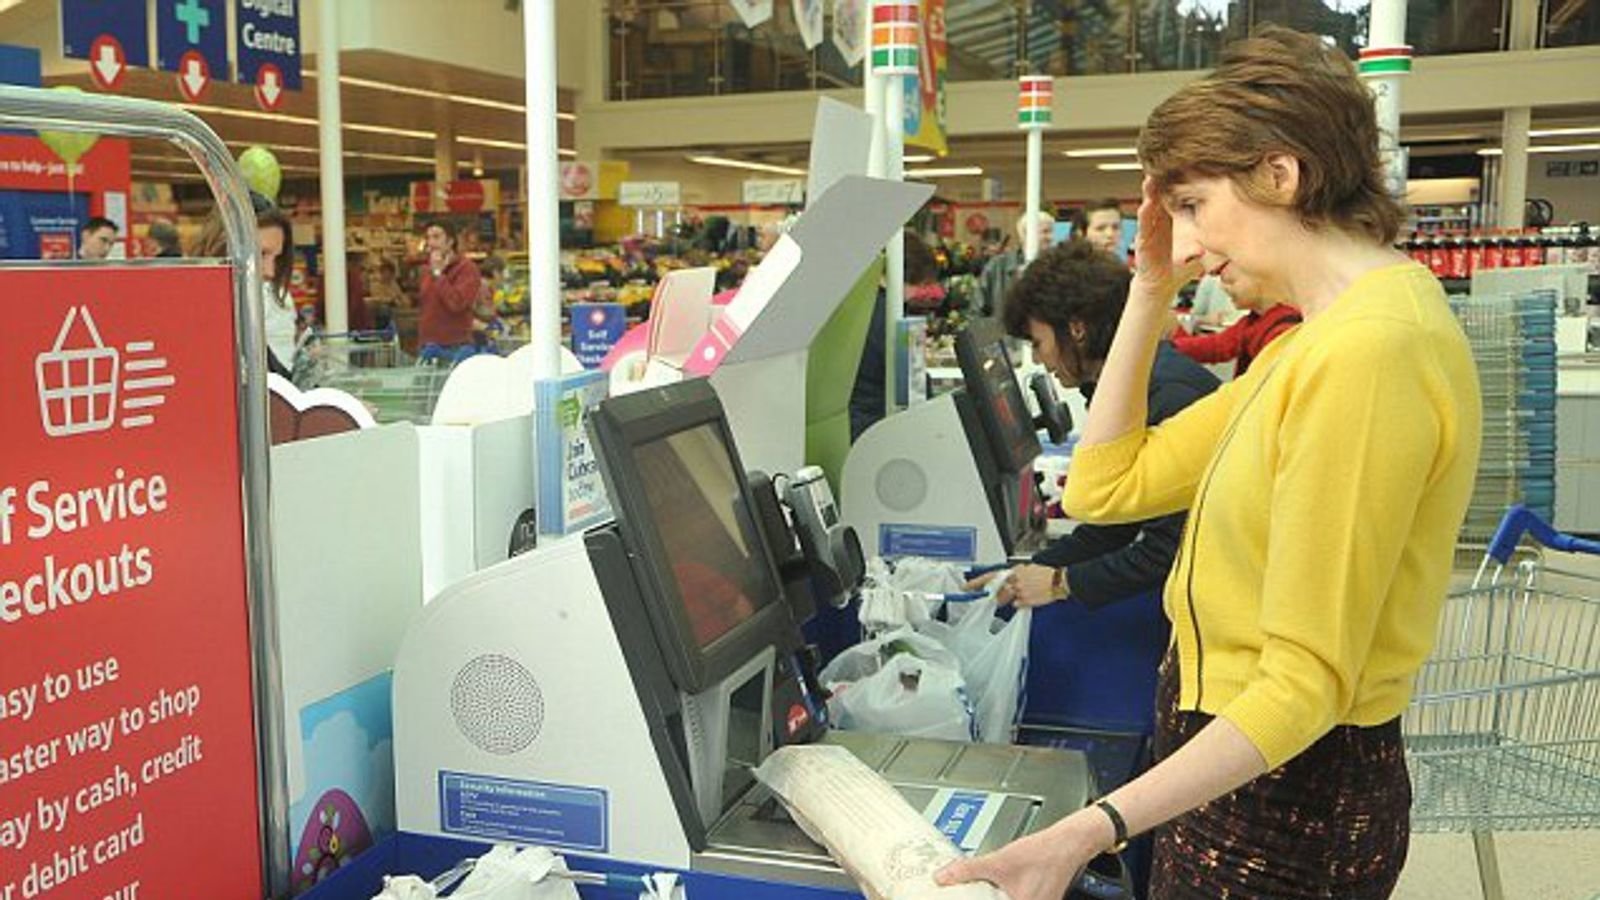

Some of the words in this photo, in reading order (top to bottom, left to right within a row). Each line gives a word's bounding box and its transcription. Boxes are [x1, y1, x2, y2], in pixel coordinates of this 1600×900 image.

[242, 22, 296, 56] Centre
[588, 329, 607, 339] Self
[26, 467, 168, 538] Service
[0, 543, 153, 622] eckouts
[43, 672, 72, 703] to
[77, 656, 119, 691] use
[65, 716, 115, 751] way
[120, 707, 144, 735] to
[149, 684, 201, 724] shop
[0, 811, 32, 850] ay
[37, 797, 69, 832] by
[75, 765, 137, 813] cash,
[141, 735, 202, 784] credit
[0, 882, 16, 900] r
[22, 845, 89, 899] debit
[93, 812, 145, 865] card
